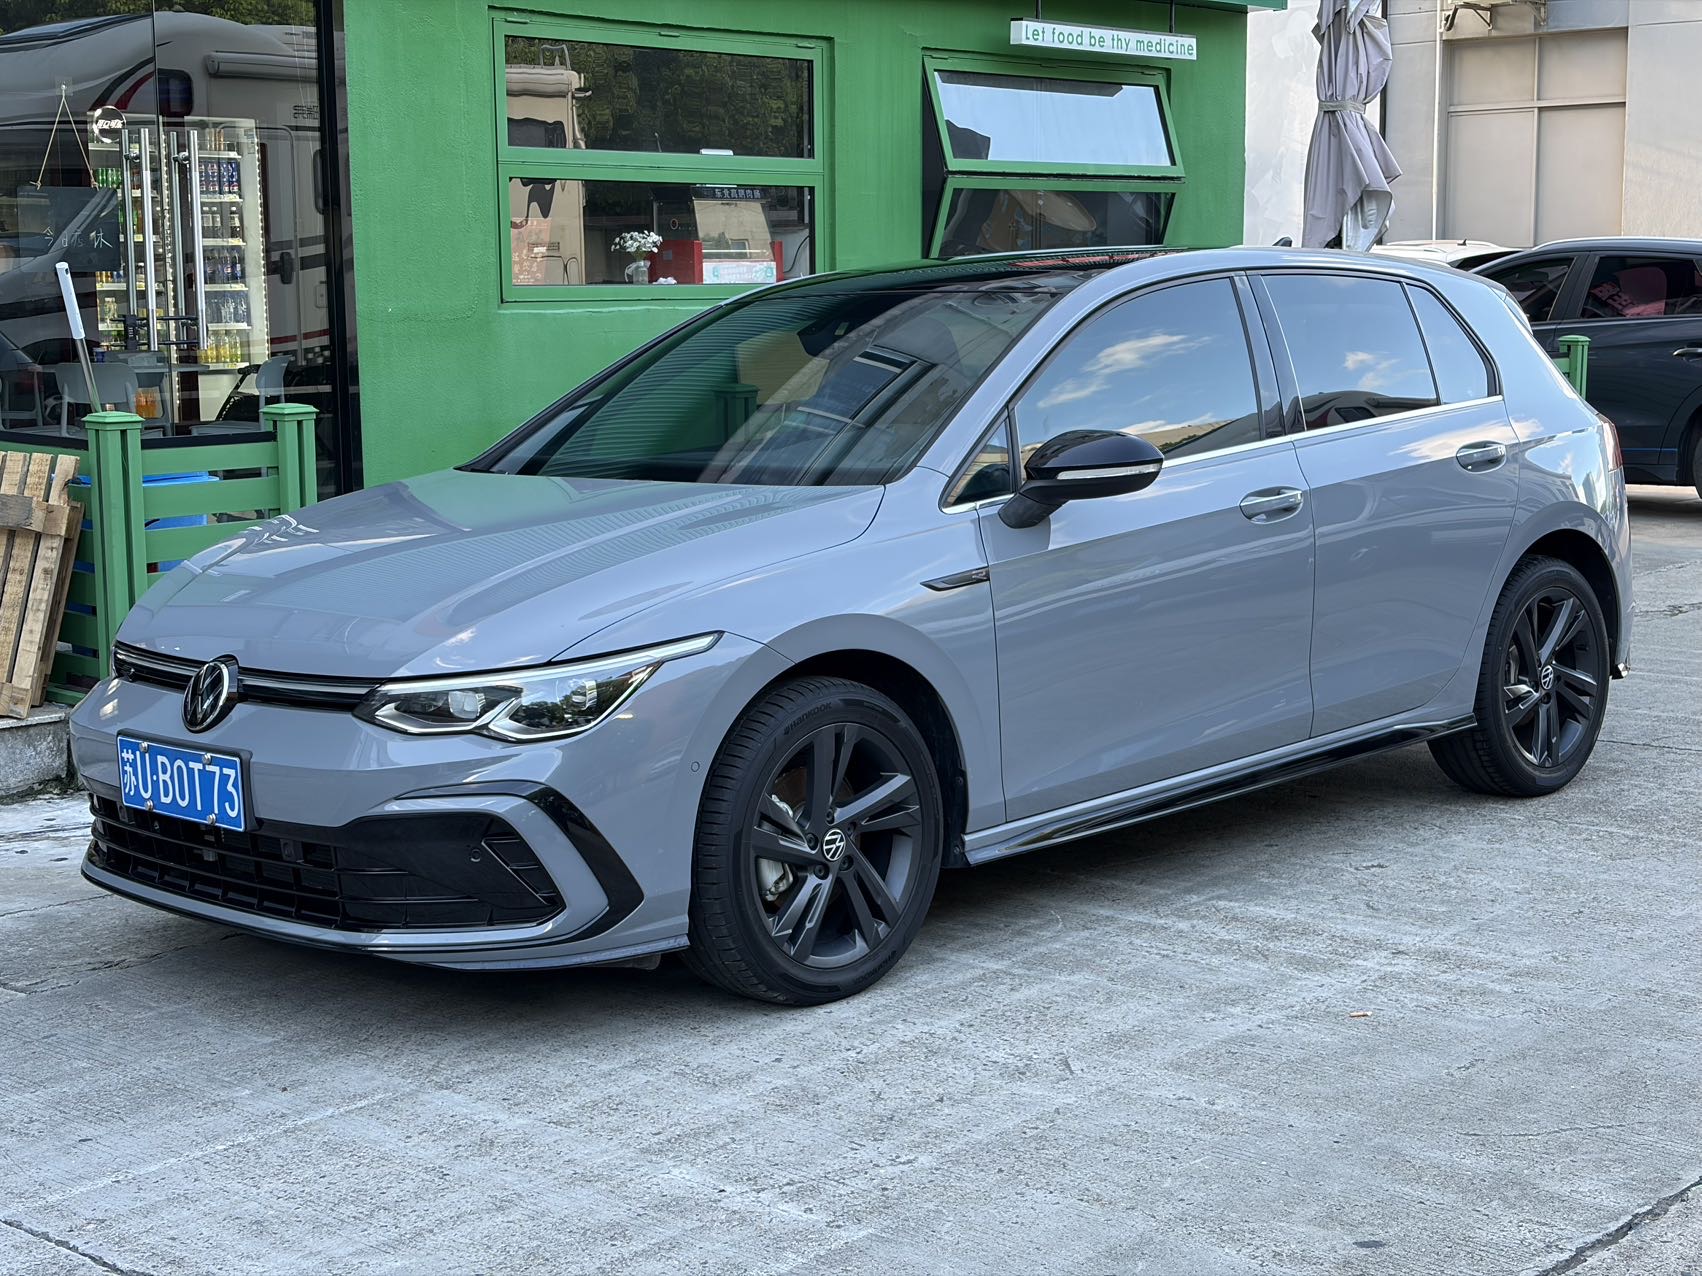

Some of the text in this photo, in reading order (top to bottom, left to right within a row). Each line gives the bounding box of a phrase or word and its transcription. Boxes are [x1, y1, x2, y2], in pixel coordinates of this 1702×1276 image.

[1025, 24, 1195, 56] Let food be thy medicine
